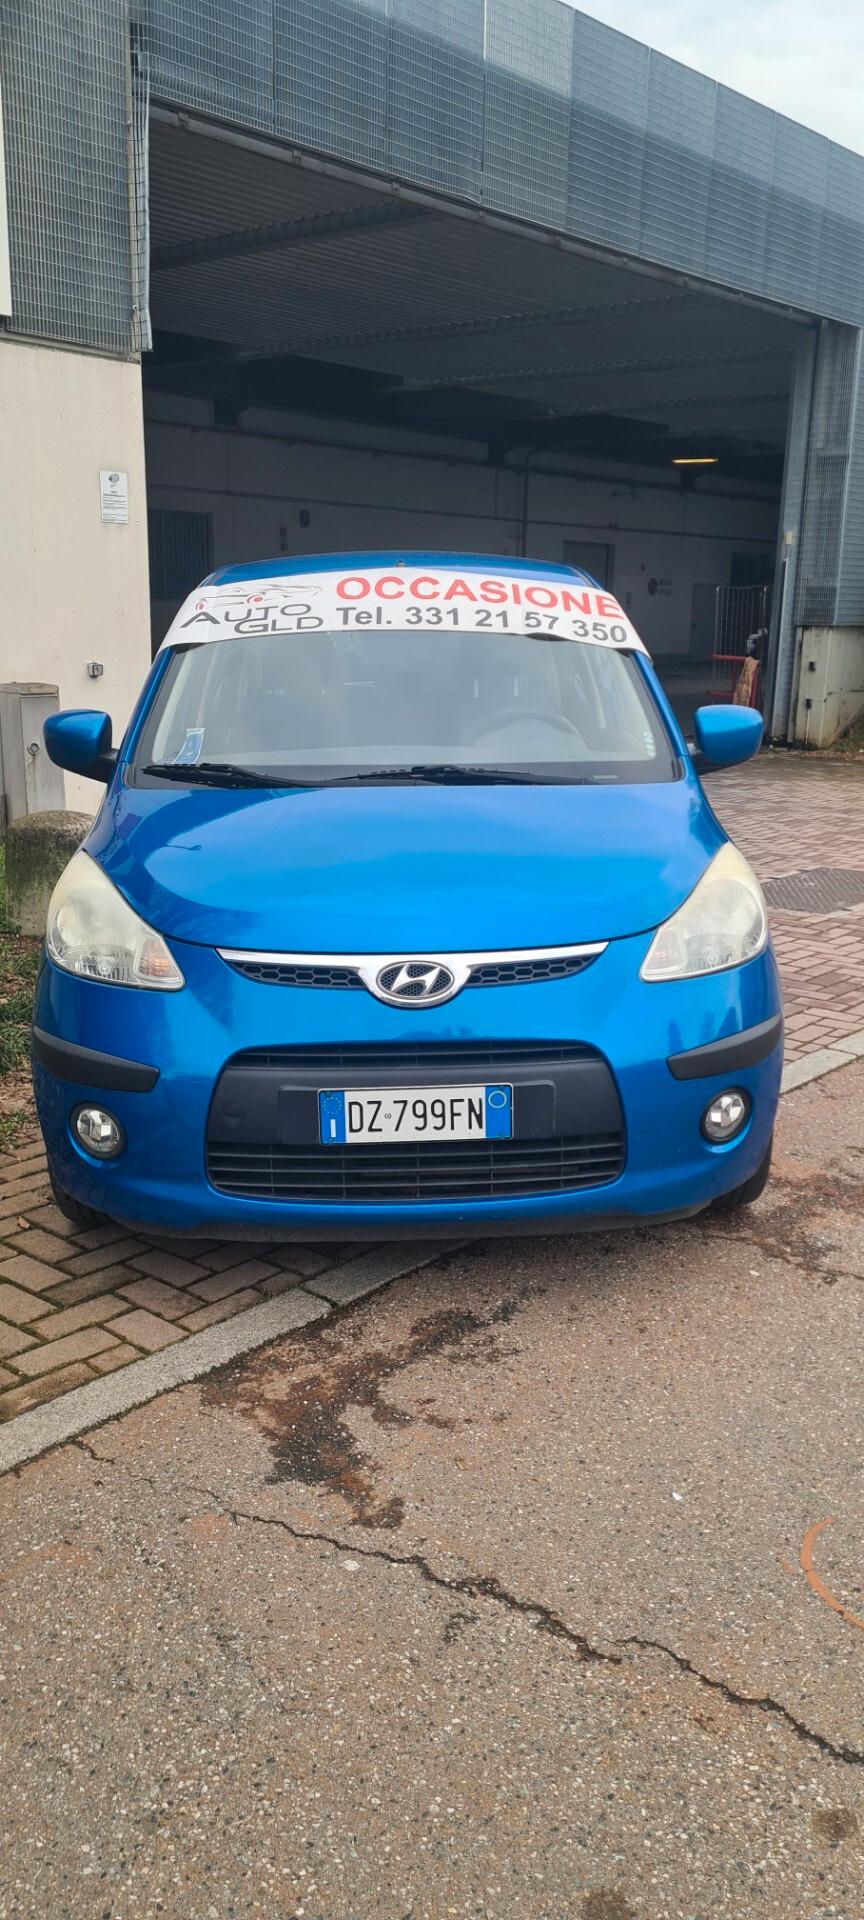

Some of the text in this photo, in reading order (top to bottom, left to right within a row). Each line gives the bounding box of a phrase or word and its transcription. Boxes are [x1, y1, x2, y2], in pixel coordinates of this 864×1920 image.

[336, 577, 623, 618] OCCASIONE
[180, 604, 312, 628] AUTO
[234, 616, 325, 635] GLD
[336, 607, 627, 643] Tel. 331 21 57 350
